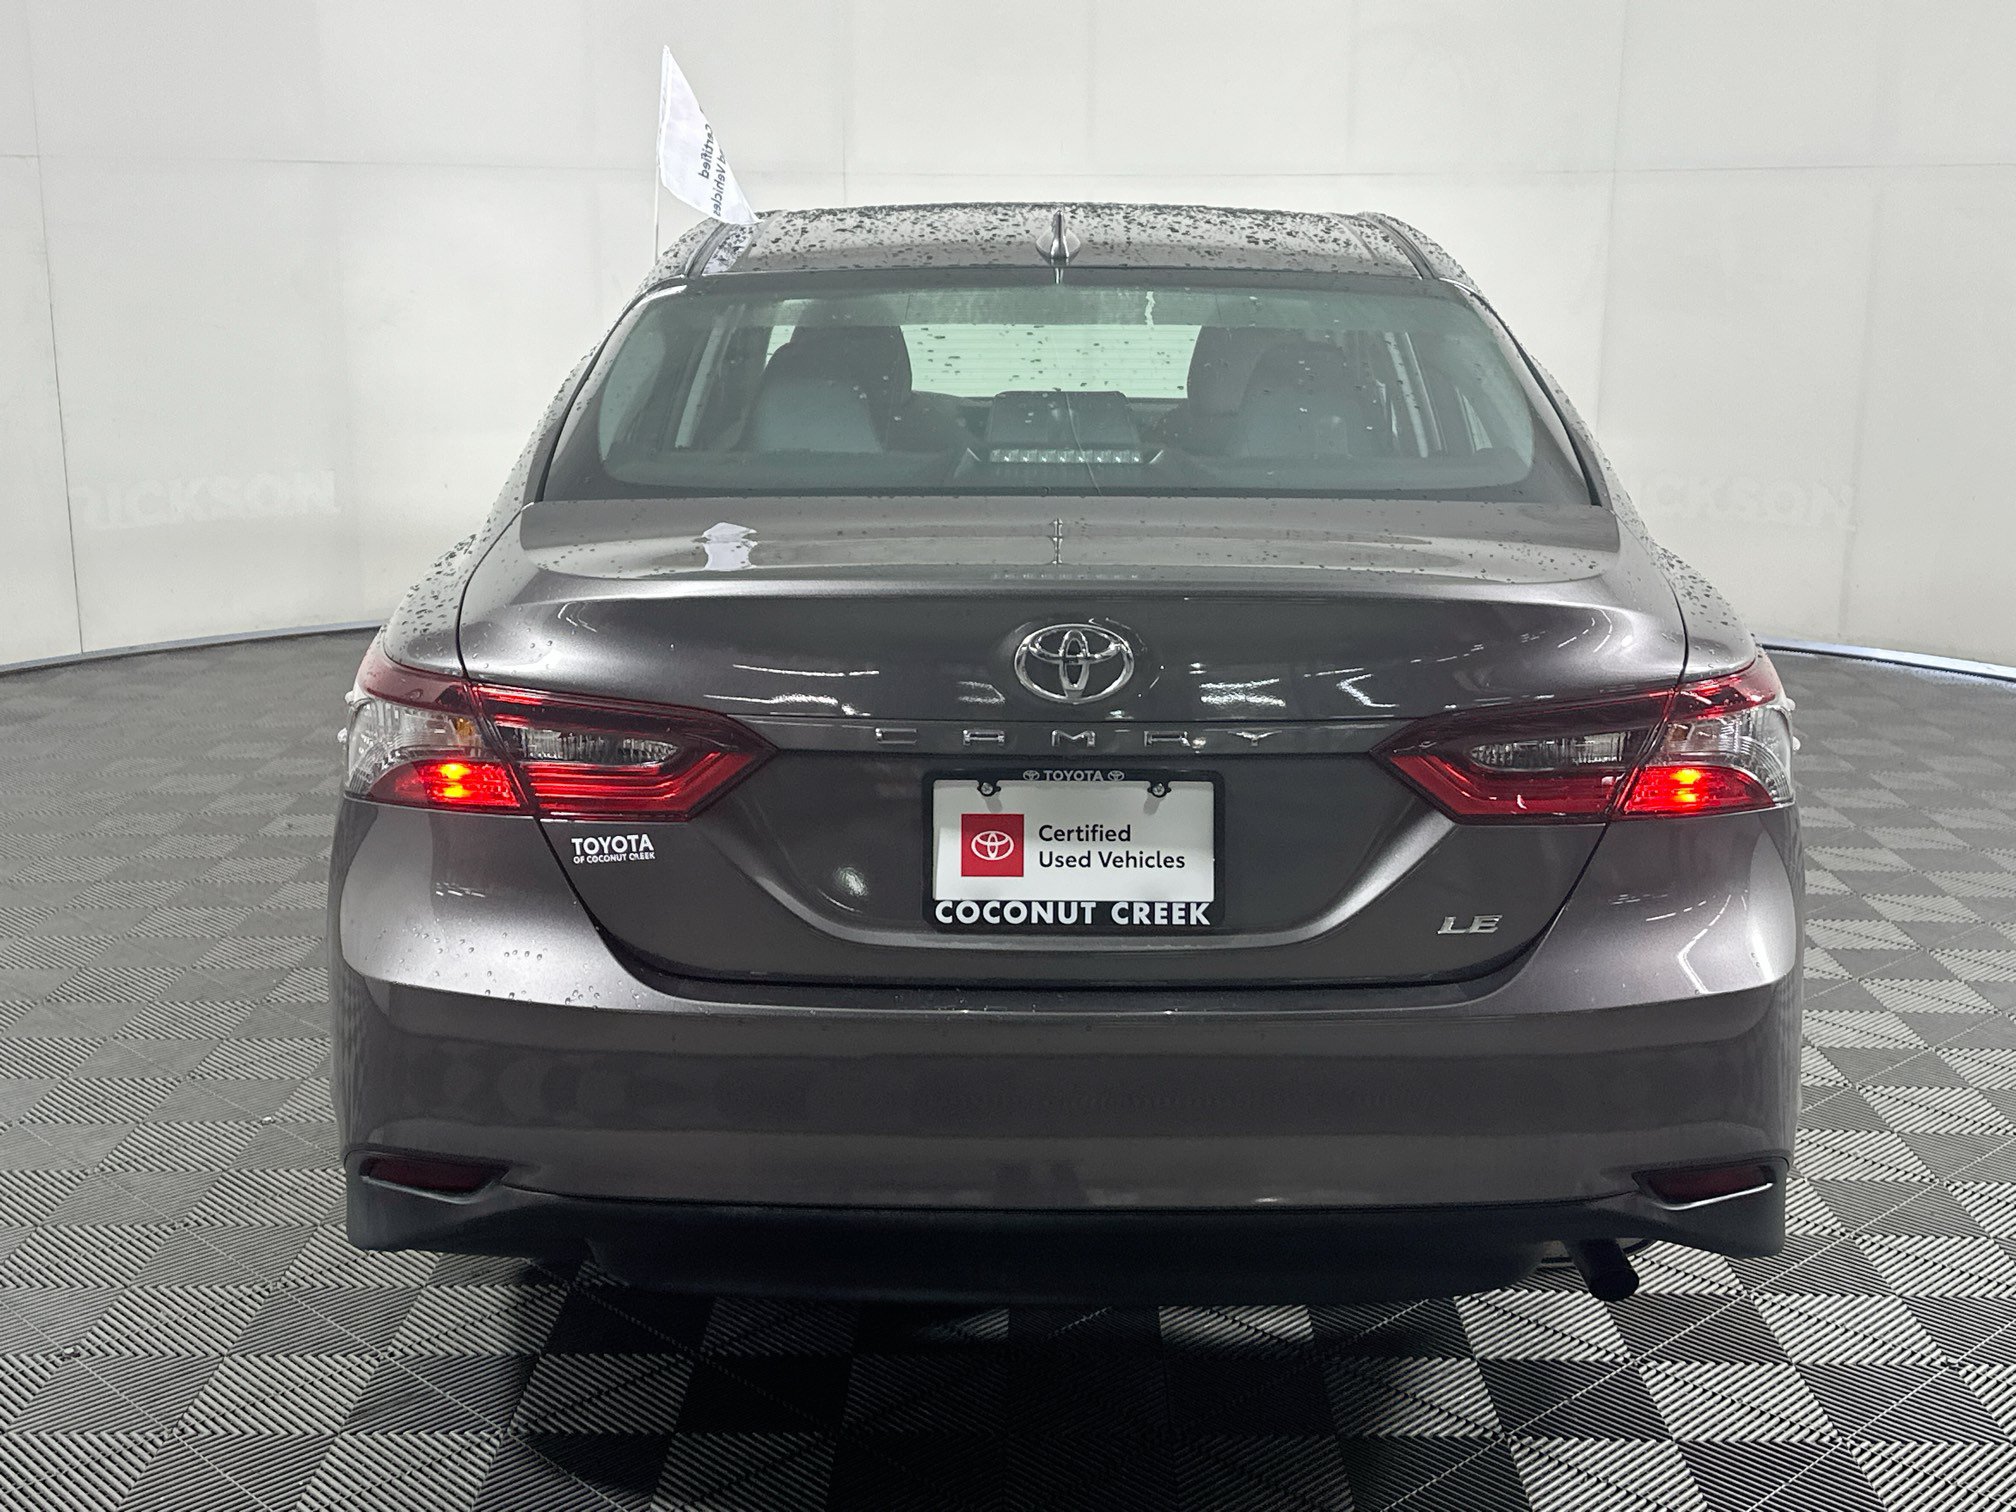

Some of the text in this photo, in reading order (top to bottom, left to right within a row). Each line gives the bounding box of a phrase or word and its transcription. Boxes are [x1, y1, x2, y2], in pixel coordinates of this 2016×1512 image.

[875, 728, 1282, 748] CAMRY
[1043, 770, 1104, 781] TOYOTA
[1038, 824, 1132, 842] Certified
[571, 834, 655, 856] TOYOTA
[573, 855, 585, 864] OF
[586, 853, 627, 864] COCONUT
[1038, 851, 1186, 869] Used Vehicles
[934, 901, 1211, 926] COCONUT CREEK
[1437, 914, 1503, 935] LE
